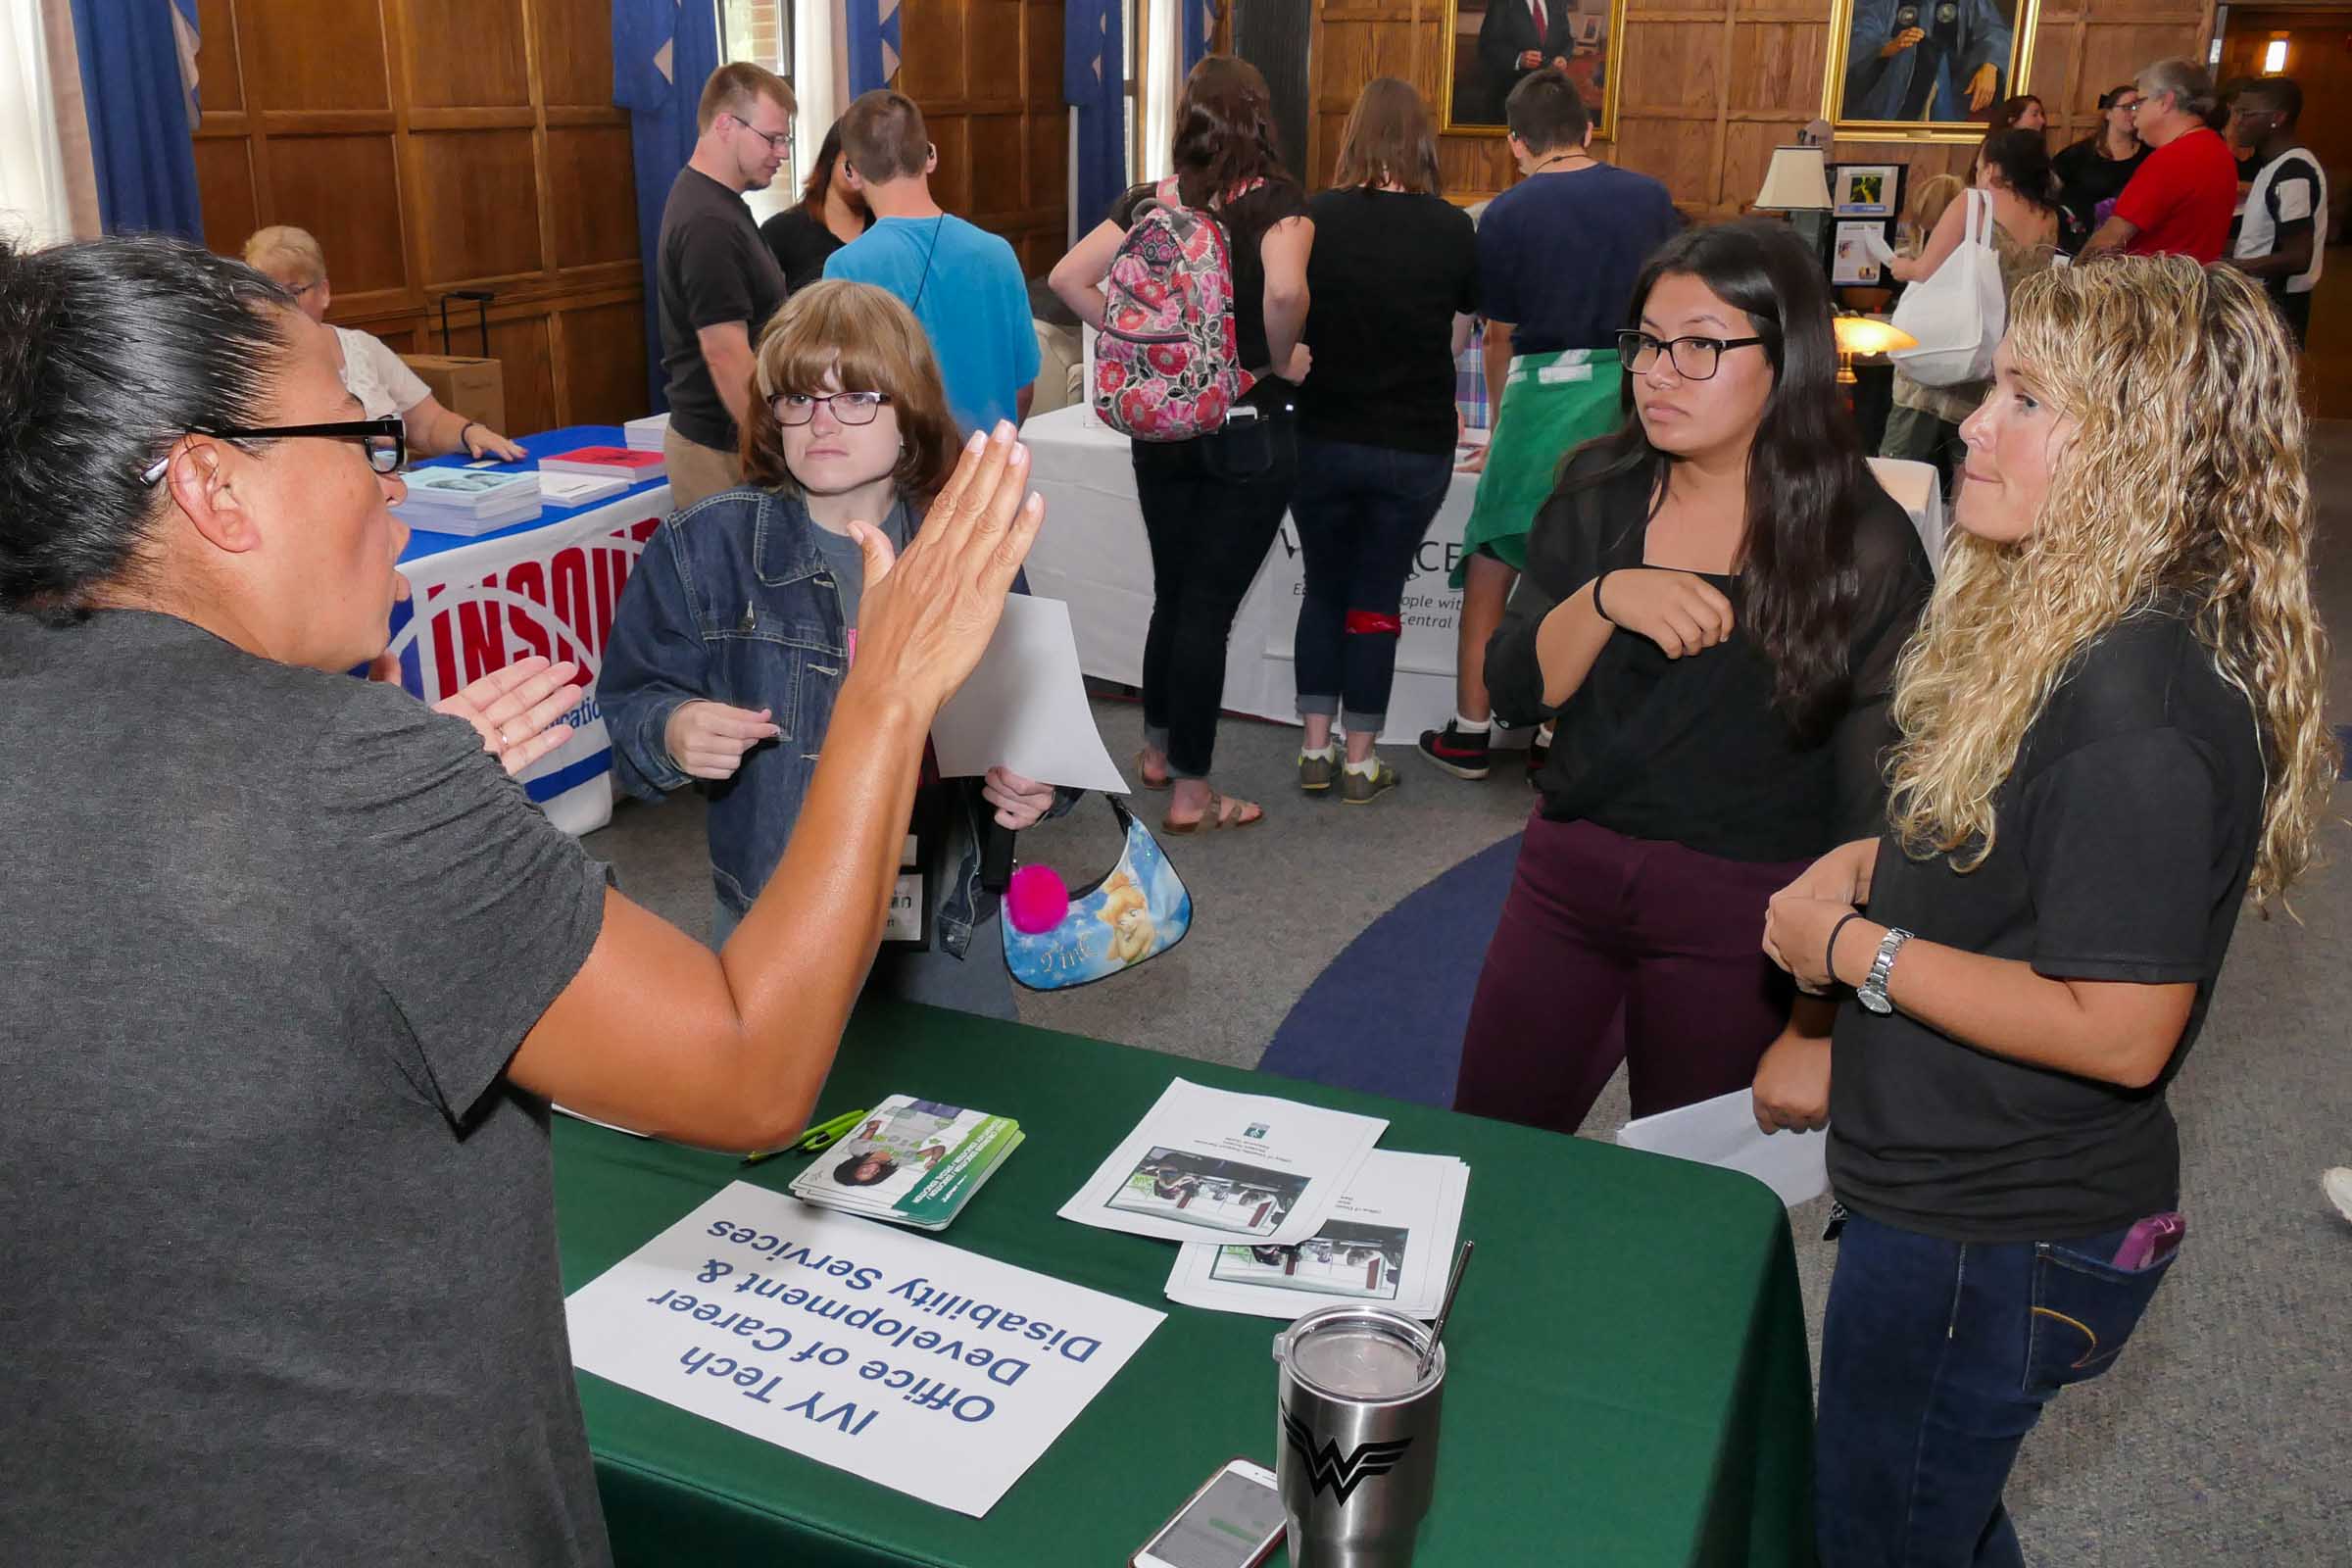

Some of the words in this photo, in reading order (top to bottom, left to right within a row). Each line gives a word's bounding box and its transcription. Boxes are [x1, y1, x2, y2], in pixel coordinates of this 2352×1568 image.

[427, 517, 662, 702] INSOU
[1399, 612, 1452, 629] Central
[1401, 595, 1433, 610] ople
[1438, 598, 1462, 611] wit
[697, 1258, 734, 1284] &
[707, 1220, 883, 1291] Services
[647, 1289, 793, 1351] Career
[733, 1273, 1031, 1387] Development
[887, 1277, 1102, 1363] Disability
[680, 1347, 783, 1403] Tech
[789, 1341, 850, 1366] of
[783, 1392, 880, 1436] IVY
[858, 1360, 996, 1423] Office
